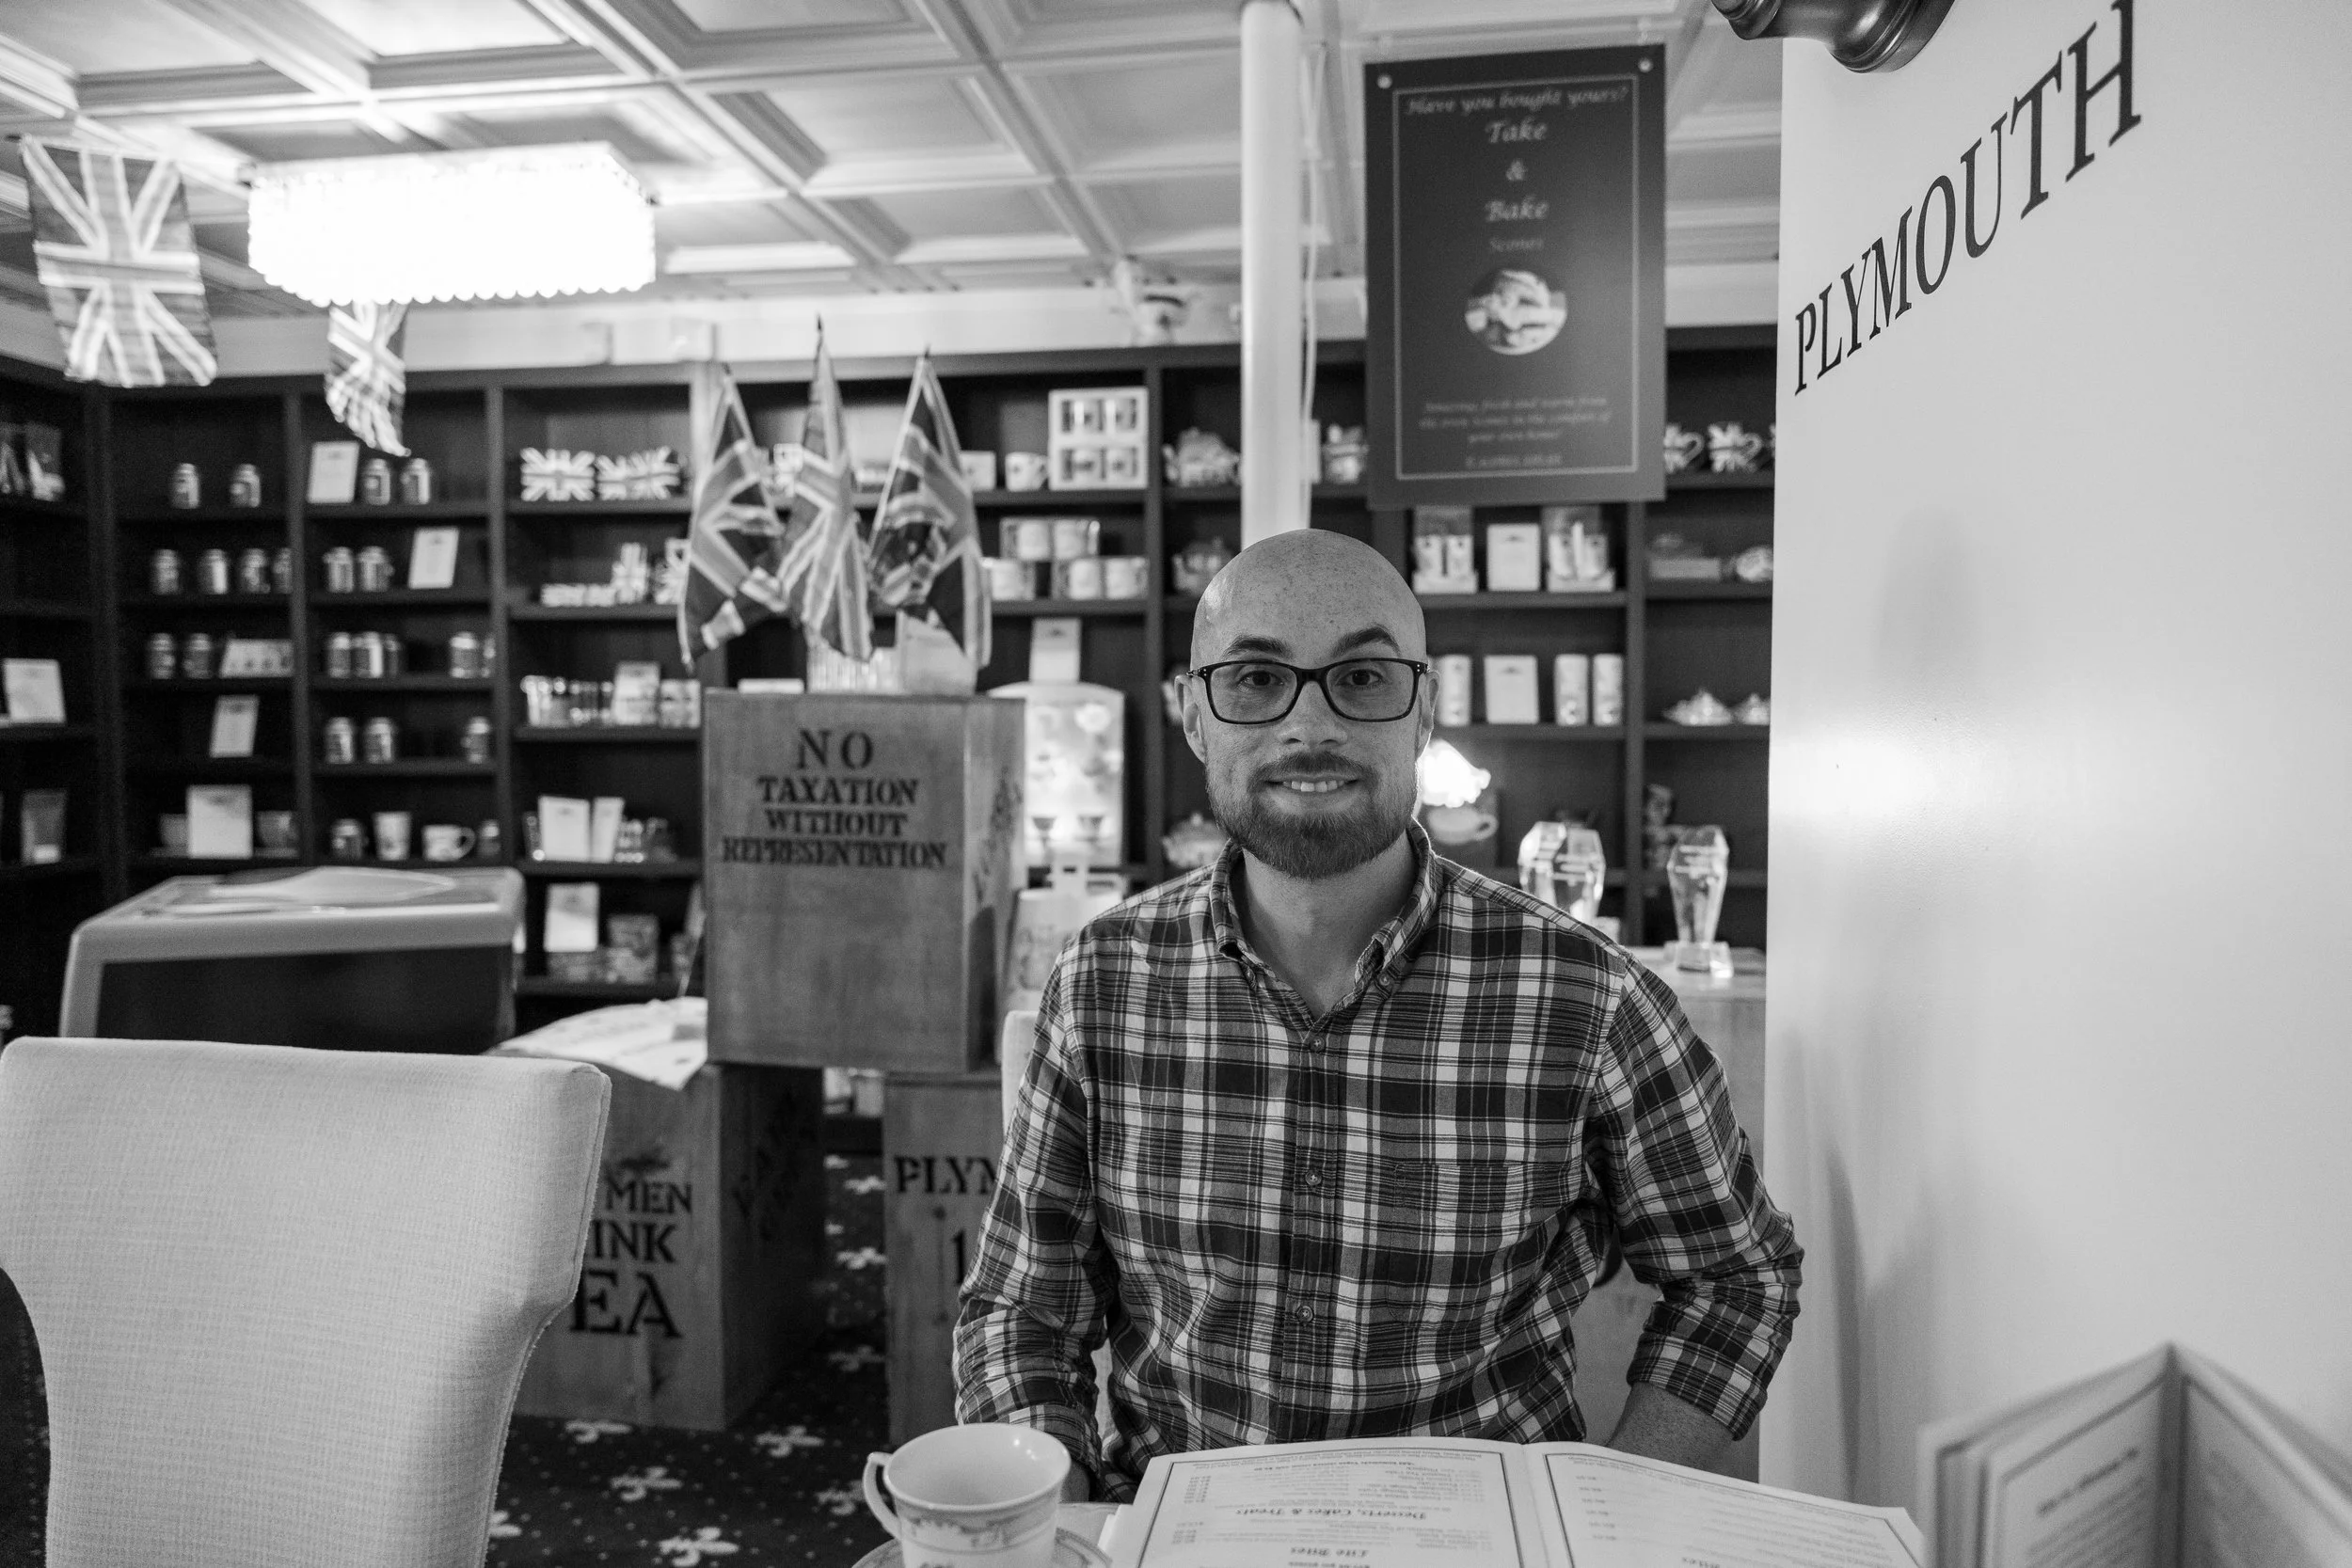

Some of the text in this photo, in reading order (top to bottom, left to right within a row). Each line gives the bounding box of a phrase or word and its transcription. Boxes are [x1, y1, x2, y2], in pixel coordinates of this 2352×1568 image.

[1486, 117, 1548, 143] Take
[1505, 158, 1528, 181] &
[1485, 195, 1550, 222] Bake
[1794, 0, 2142, 396] PLYMOUTH
[798, 728, 874, 770] NO
[756, 775, 919, 806] TAXATION
[765, 808, 909, 837] WITHOUT
[722, 835, 946, 869] REPRESENTATION
[591, 1219, 676, 1263] INK
[569, 1270, 684, 1338] EA
